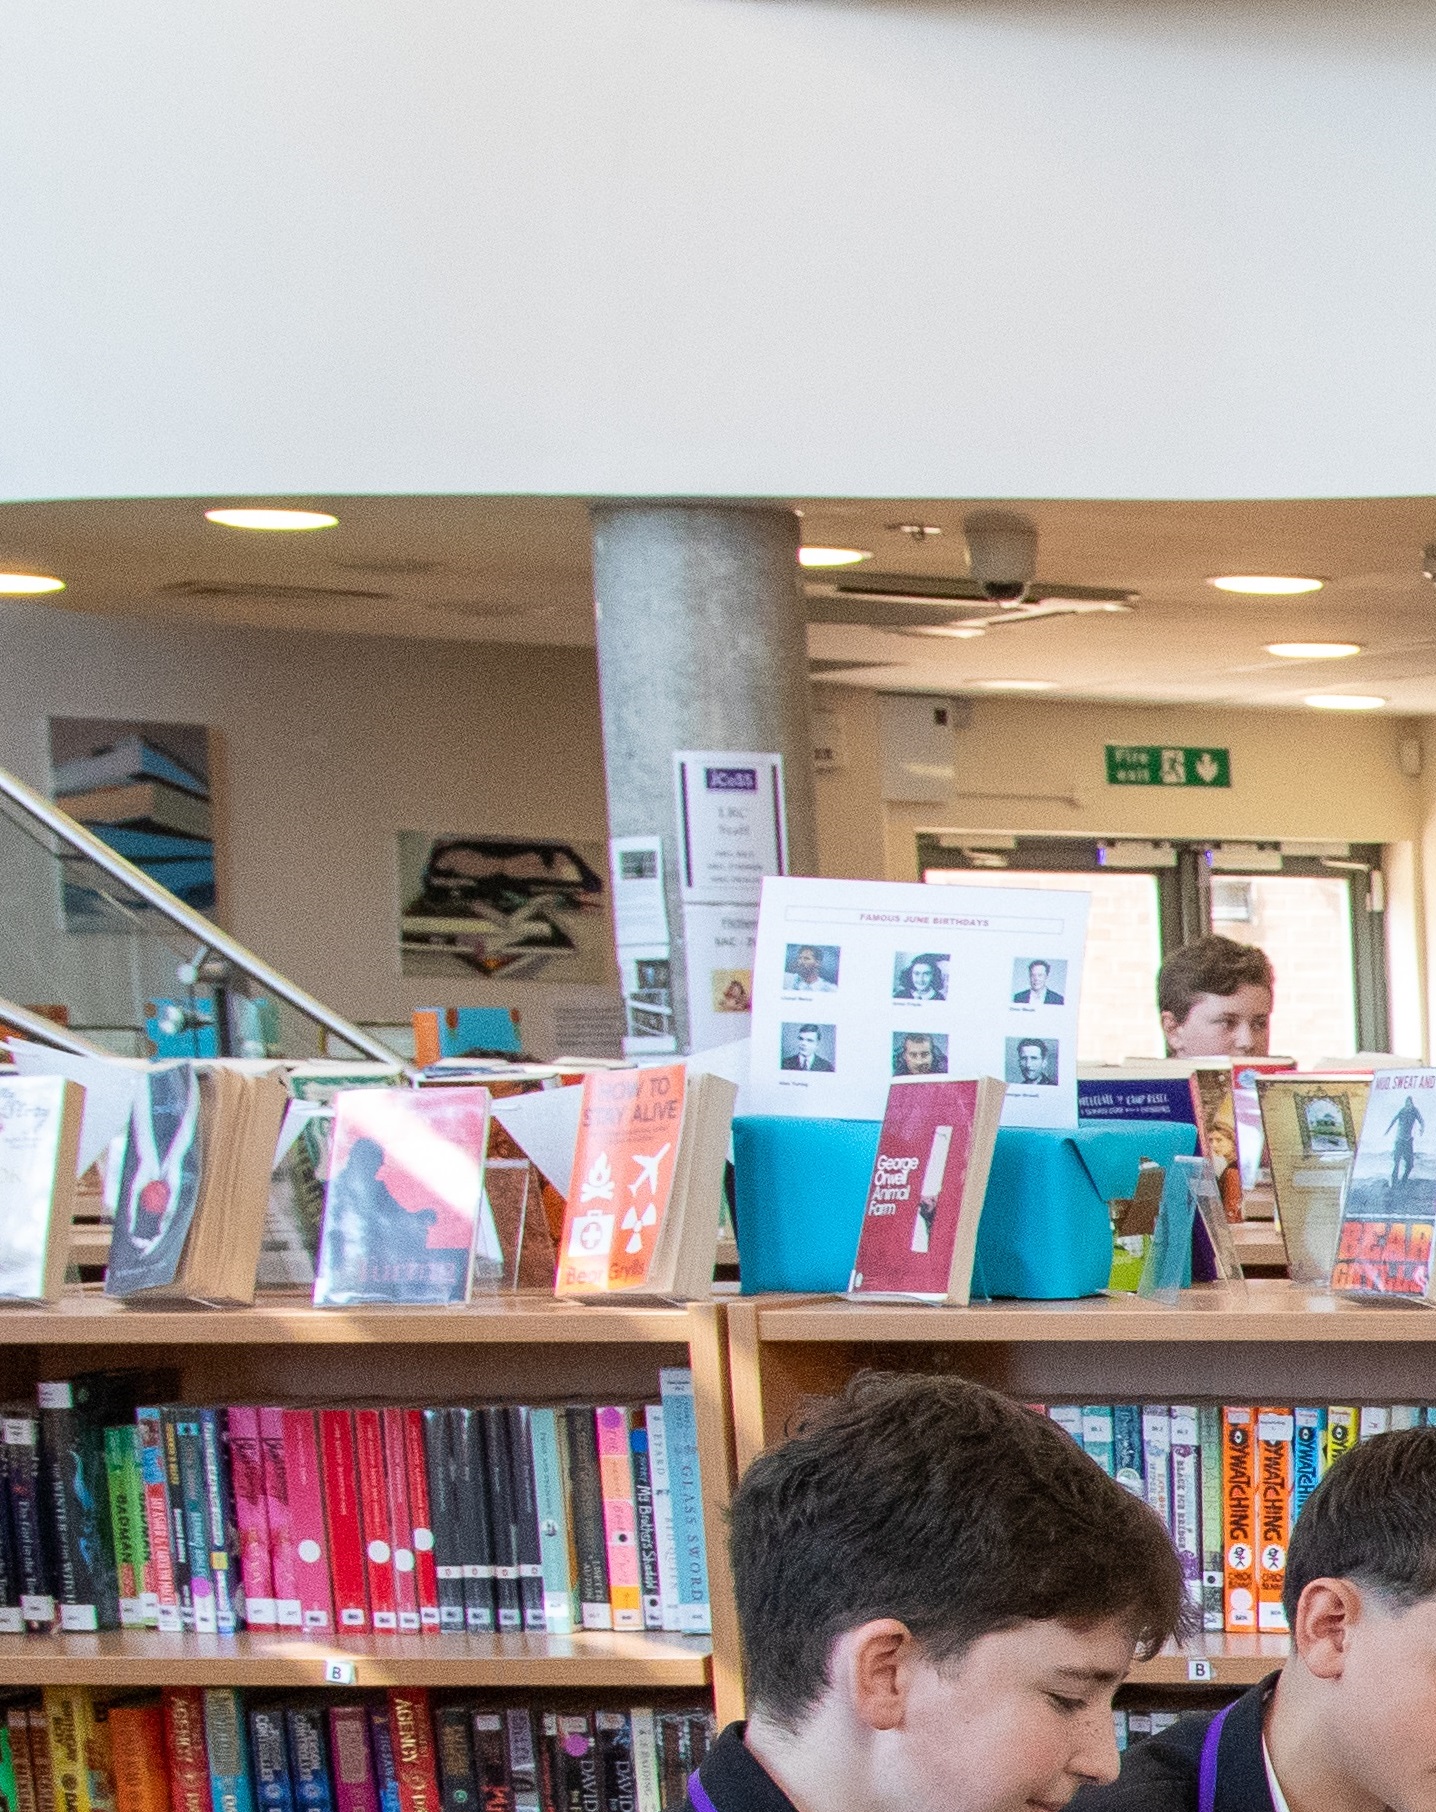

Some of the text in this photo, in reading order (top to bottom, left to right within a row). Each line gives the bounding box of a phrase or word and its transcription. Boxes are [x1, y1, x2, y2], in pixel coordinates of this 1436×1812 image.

[859, 913, 990, 928] FAMOUS JUNE BIRTHDAYS
[650, 1077, 671, 1095] TO
[1392, 1075, 1418, 1090] SWEAT
[1419, 1075, 1436, 1089] AND
[633, 1101, 679, 1122] ALIVE
[877, 1155, 919, 1172] George
[874, 1170, 909, 1187] Orwell
[871, 1186, 910, 1201] Animal
[868, 1200, 896, 1216] Farm
[1337, 1221, 1433, 1261] BEAR
[54, 1481, 68, 1531] WINTER
[116, 1494, 133, 1564] BADMAN
[636, 1484, 658, 1590] My Brother's Shadow
[681, 1465, 705, 1602] GLASS SWORD
[331, 1667, 342, 1680] B
[1195, 1662, 1205, 1677] B
[395, 1698, 417, 1764] AGENCY
[581, 1759, 599, 1812] DAVID
